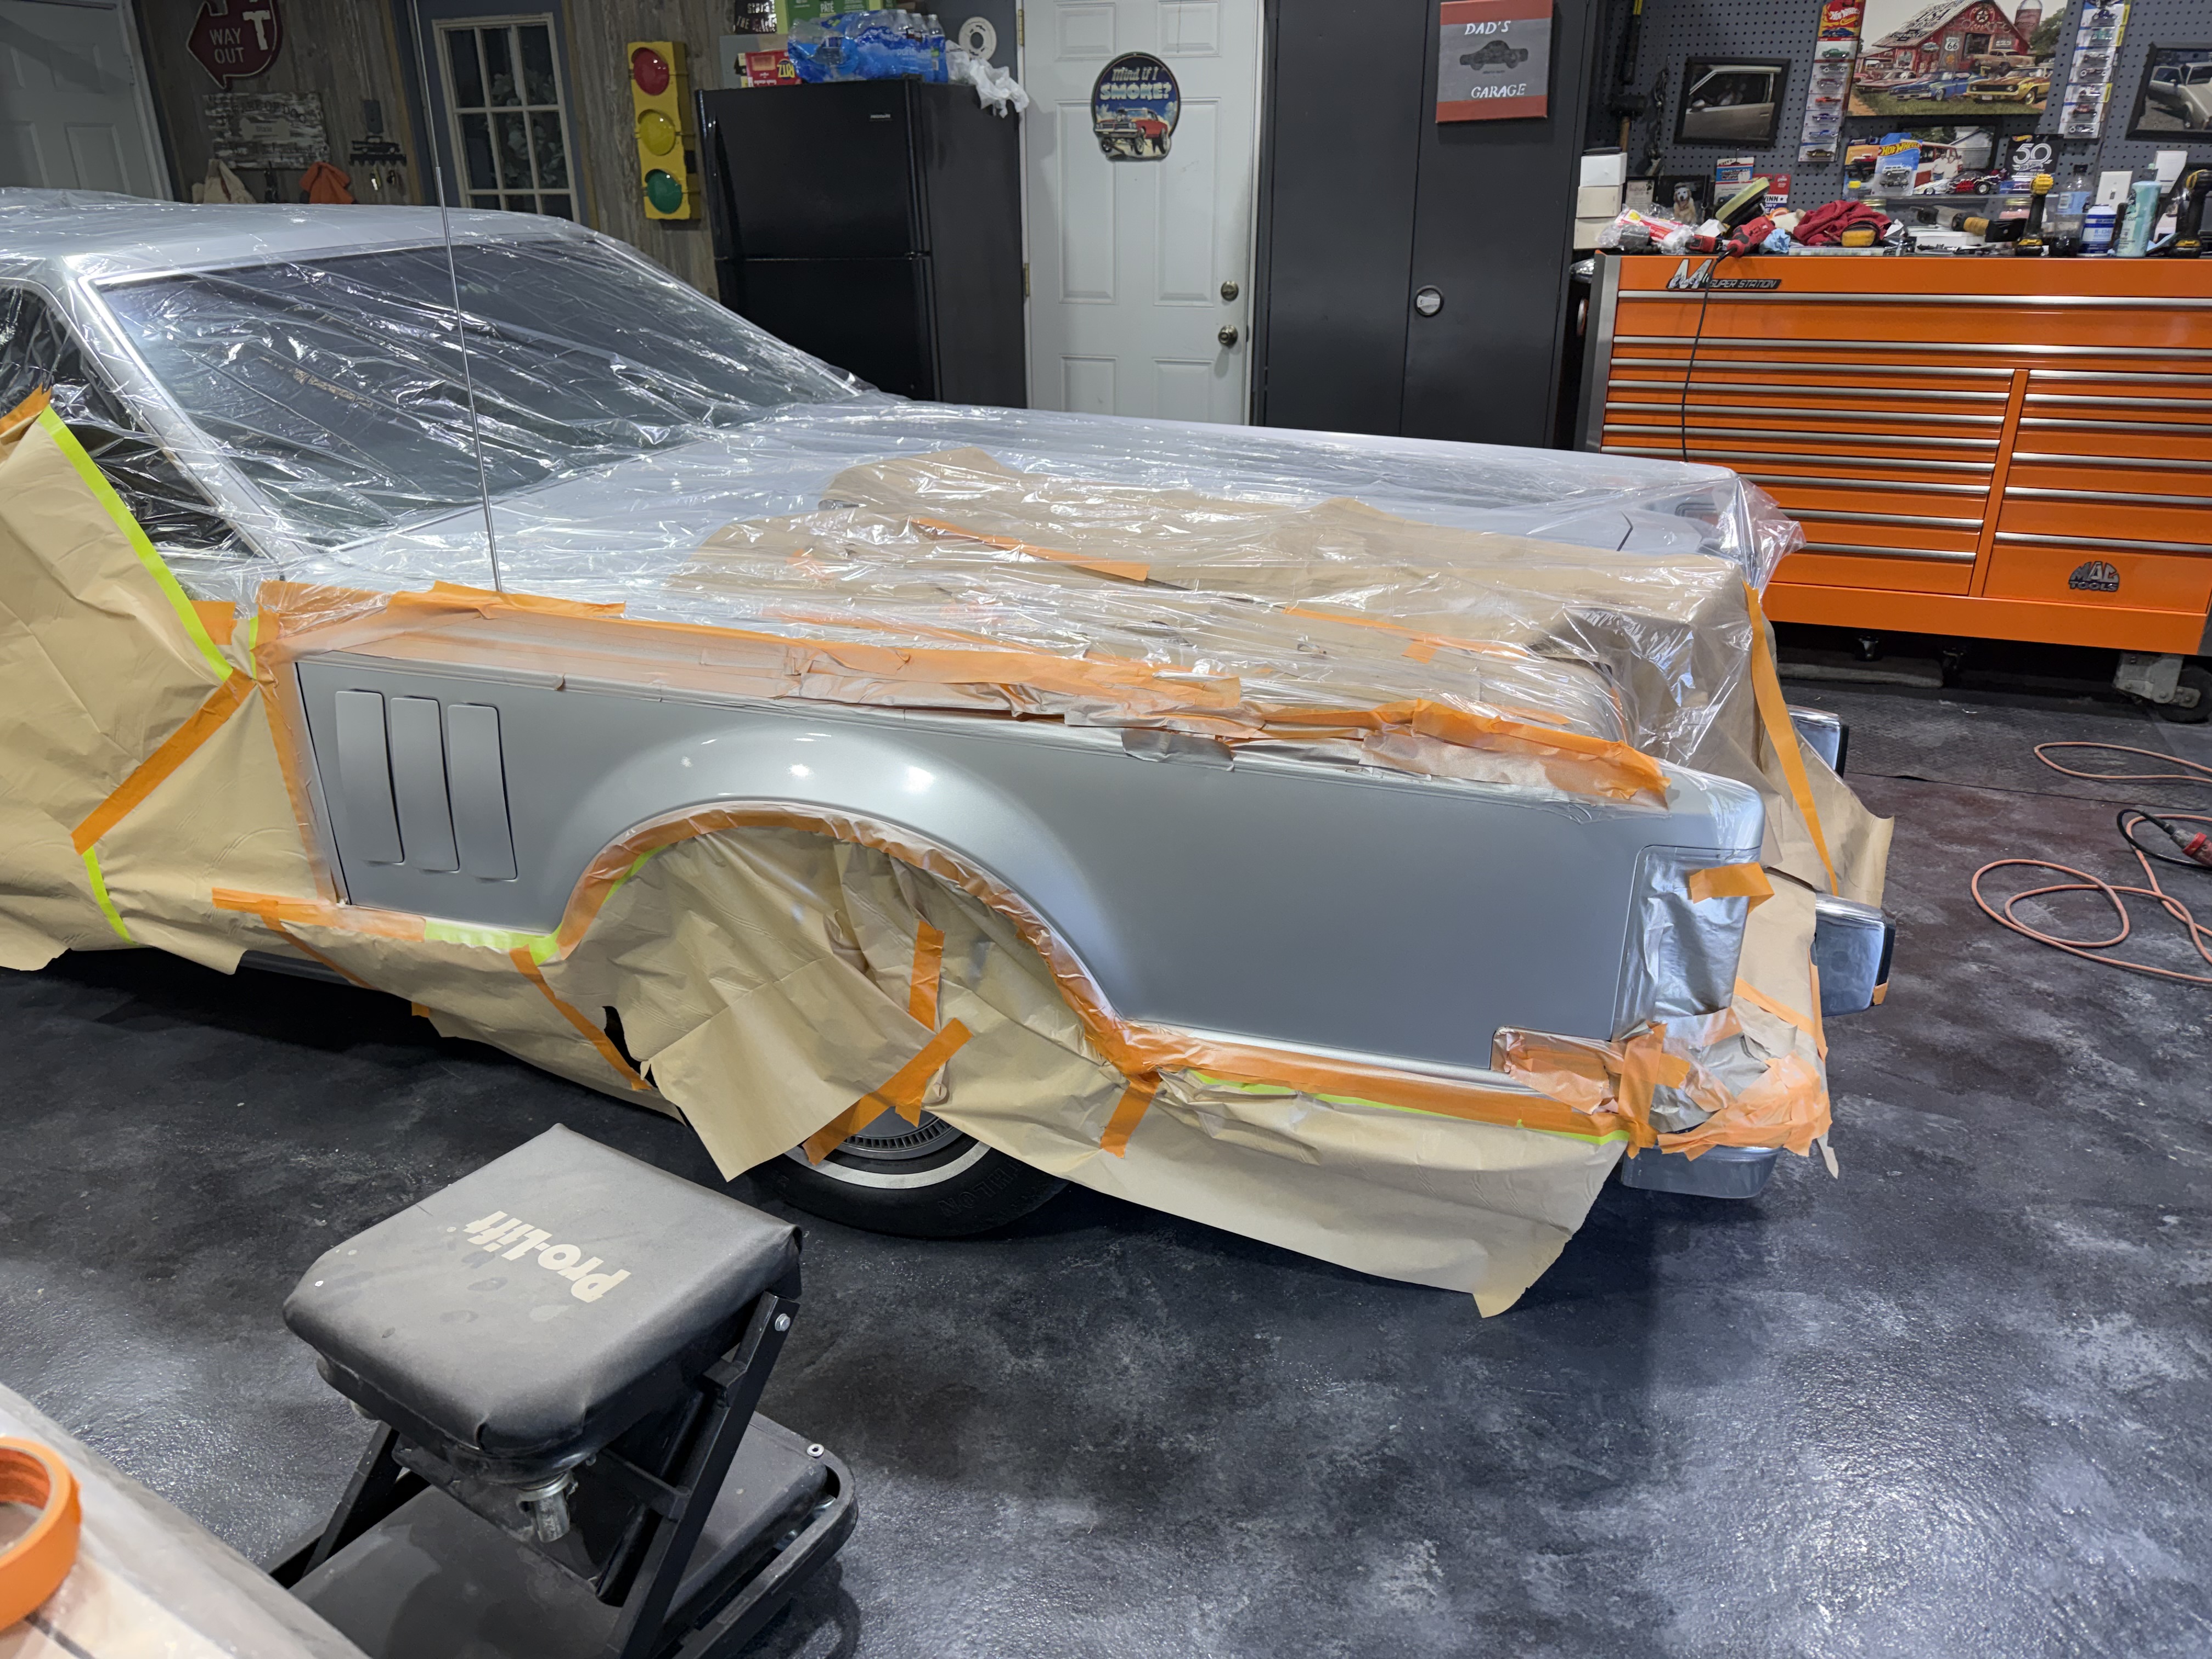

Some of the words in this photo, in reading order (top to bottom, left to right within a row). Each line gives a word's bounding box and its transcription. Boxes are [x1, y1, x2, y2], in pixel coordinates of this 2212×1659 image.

[1916, 8, 1951, 22] USA
[1464, 20, 1512, 36] DAD'S
[210, 28, 241, 45] WAY
[214, 47, 245, 64] OUT
[777, 63, 795, 78] RITZ
[1113, 67, 1140, 81] Mind
[1141, 67, 1151, 81] if
[1152, 66, 1159, 81] I
[1100, 83, 1172, 100] SMOKE?
[1471, 83, 1527, 99] GARAGE
[1880, 145, 1897, 156] HOT
[1895, 142, 1920, 154] WHEELS
[2012, 143, 2052, 165] 50
[1709, 279, 1736, 288] SUPER
[1738, 279, 1777, 288] STATION
[2069, 561, 2119, 583] MAC
[2069, 581, 2119, 591] TOOLS
[462, 1210, 631, 1304] Pro-Lift
